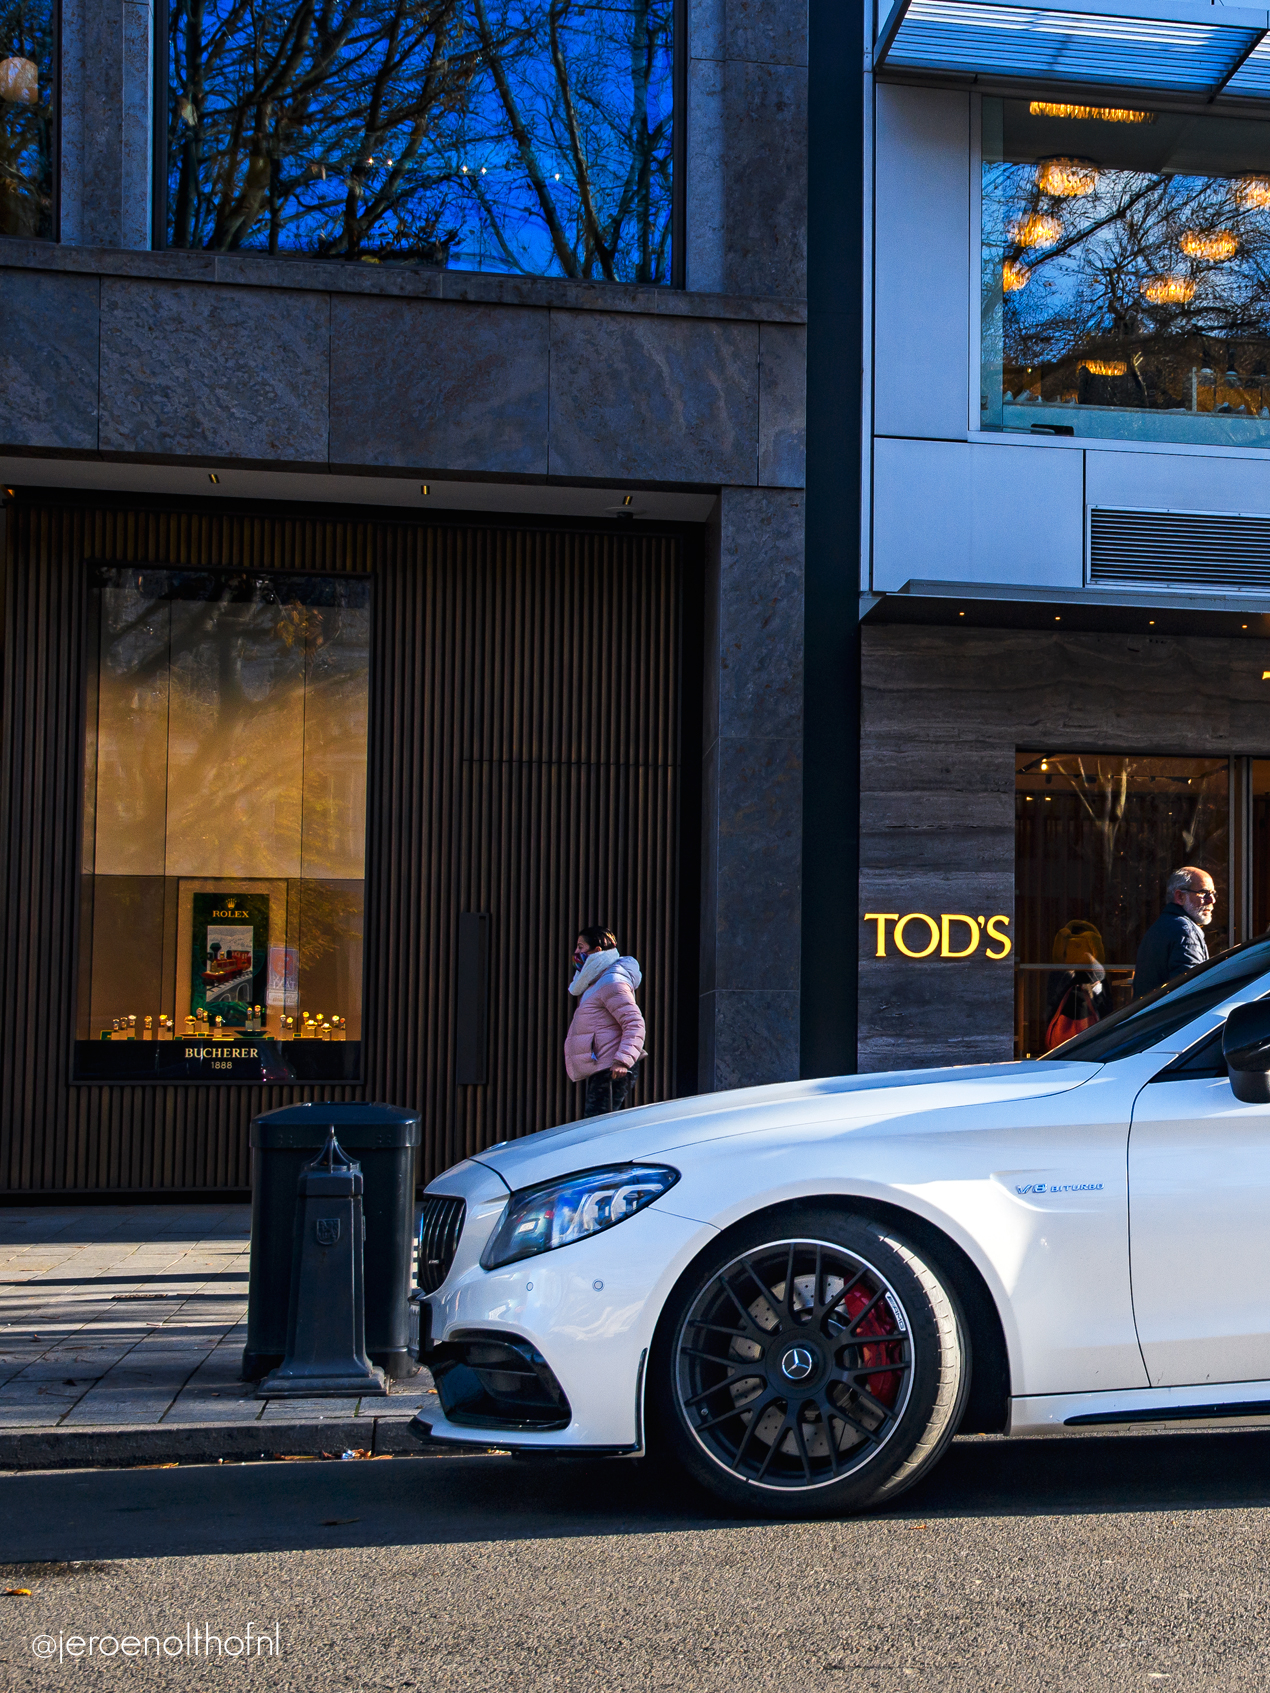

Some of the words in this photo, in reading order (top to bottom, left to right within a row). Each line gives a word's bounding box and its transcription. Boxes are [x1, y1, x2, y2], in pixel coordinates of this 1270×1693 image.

[212, 910, 249, 918] ROLEX
[864, 912, 1012, 960] TOD'S
[185, 1047, 259, 1059] BUCHERER
[211, 1061, 233, 1070] 1888
[1015, 1183, 1048, 1195] V8
[1050, 1183, 1105, 1193] BITURBO
